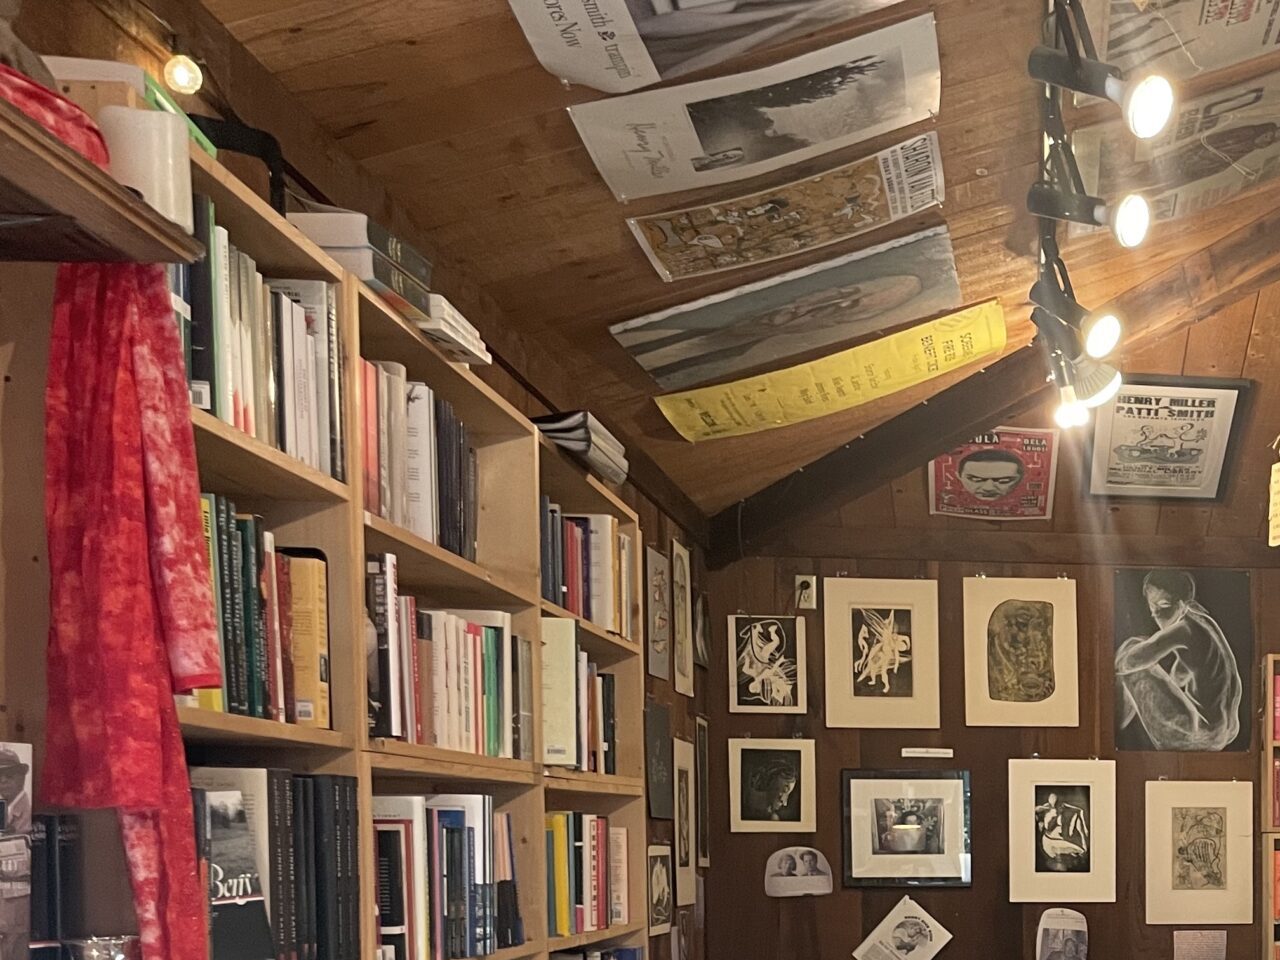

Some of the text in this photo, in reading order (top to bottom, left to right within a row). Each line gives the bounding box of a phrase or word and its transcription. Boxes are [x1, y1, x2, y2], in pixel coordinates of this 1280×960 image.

[555, 20, 582, 49] Now
[900, 137, 933, 179] SHARON
[1115, 405, 1215, 419] PATTI SMITH
[1117, 395, 1216, 409] HENRY MILLER
[211, 863, 260, 901] Berry
